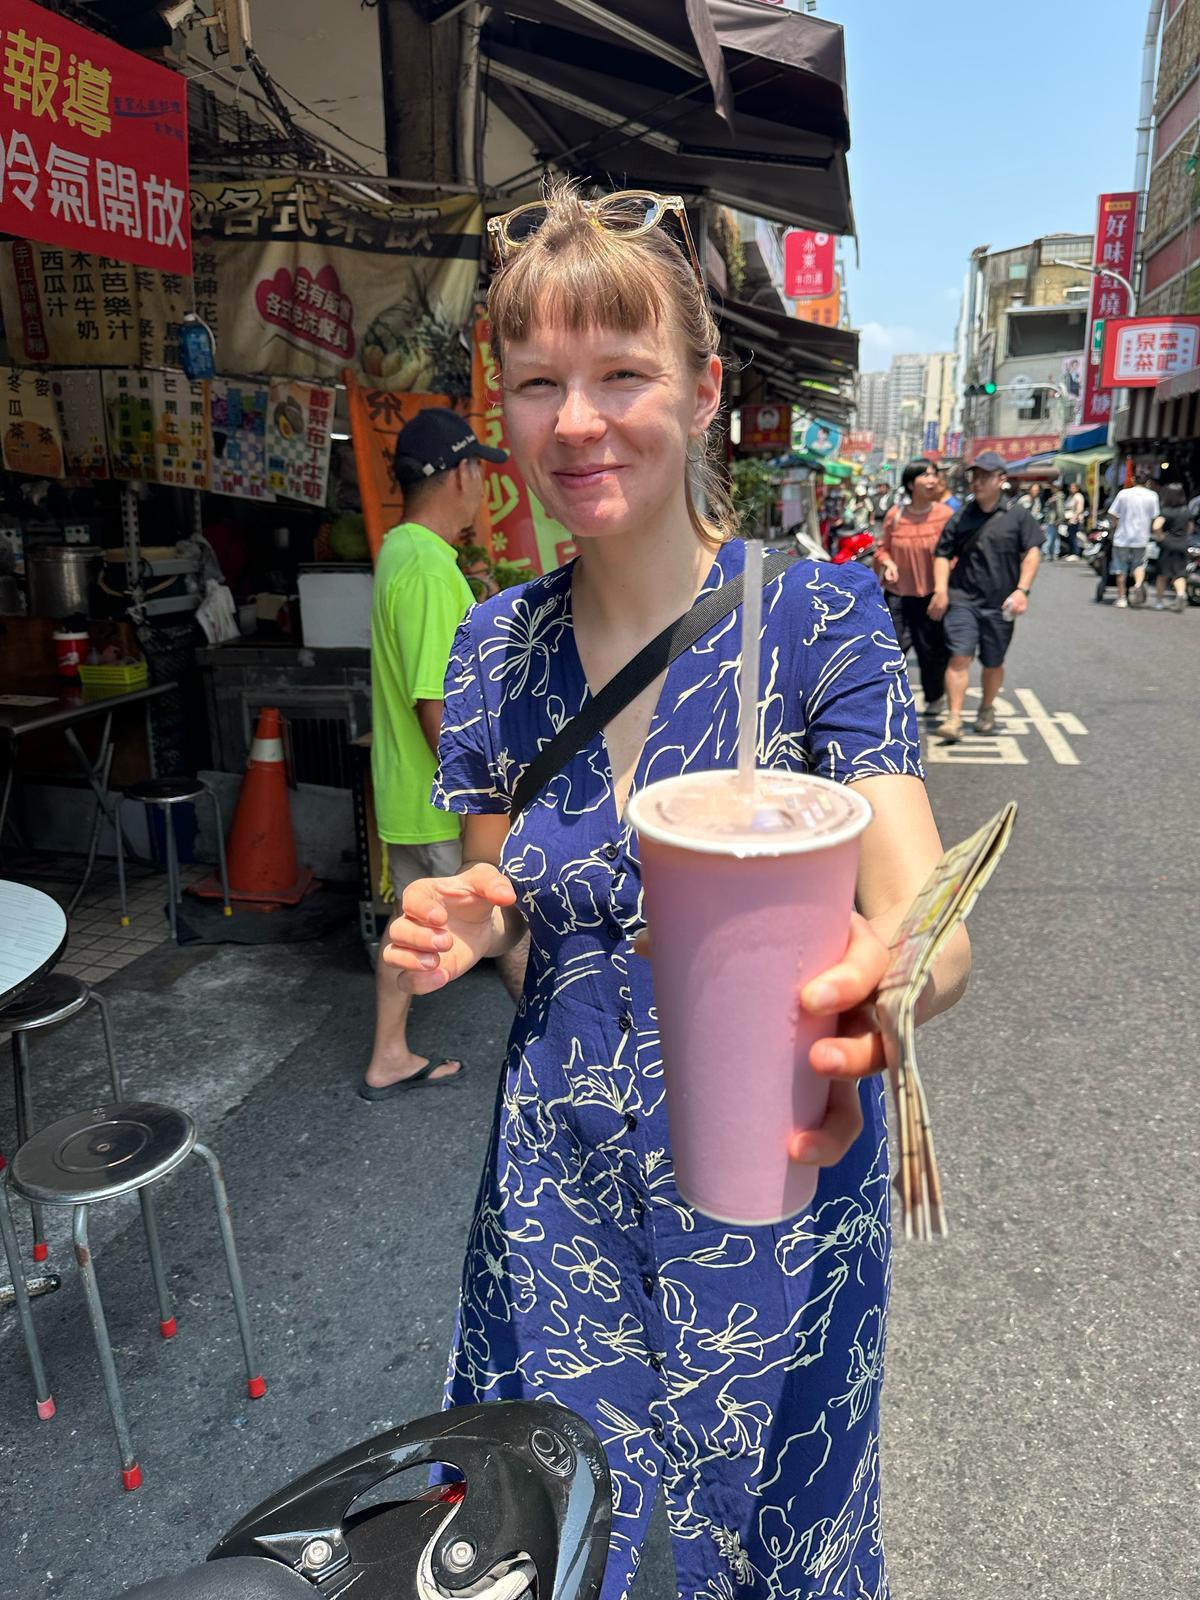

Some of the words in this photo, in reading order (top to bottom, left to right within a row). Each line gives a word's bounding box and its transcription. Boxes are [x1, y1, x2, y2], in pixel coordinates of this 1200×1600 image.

[4, 28, 112, 138] 報導
[0, 128, 187, 250] 冷氣開放
[41, 251, 68, 317] 西瓜汁
[71, 251, 99, 340] 木瓜牛奶
[7, 370, 25, 441] 冬瓜茶
